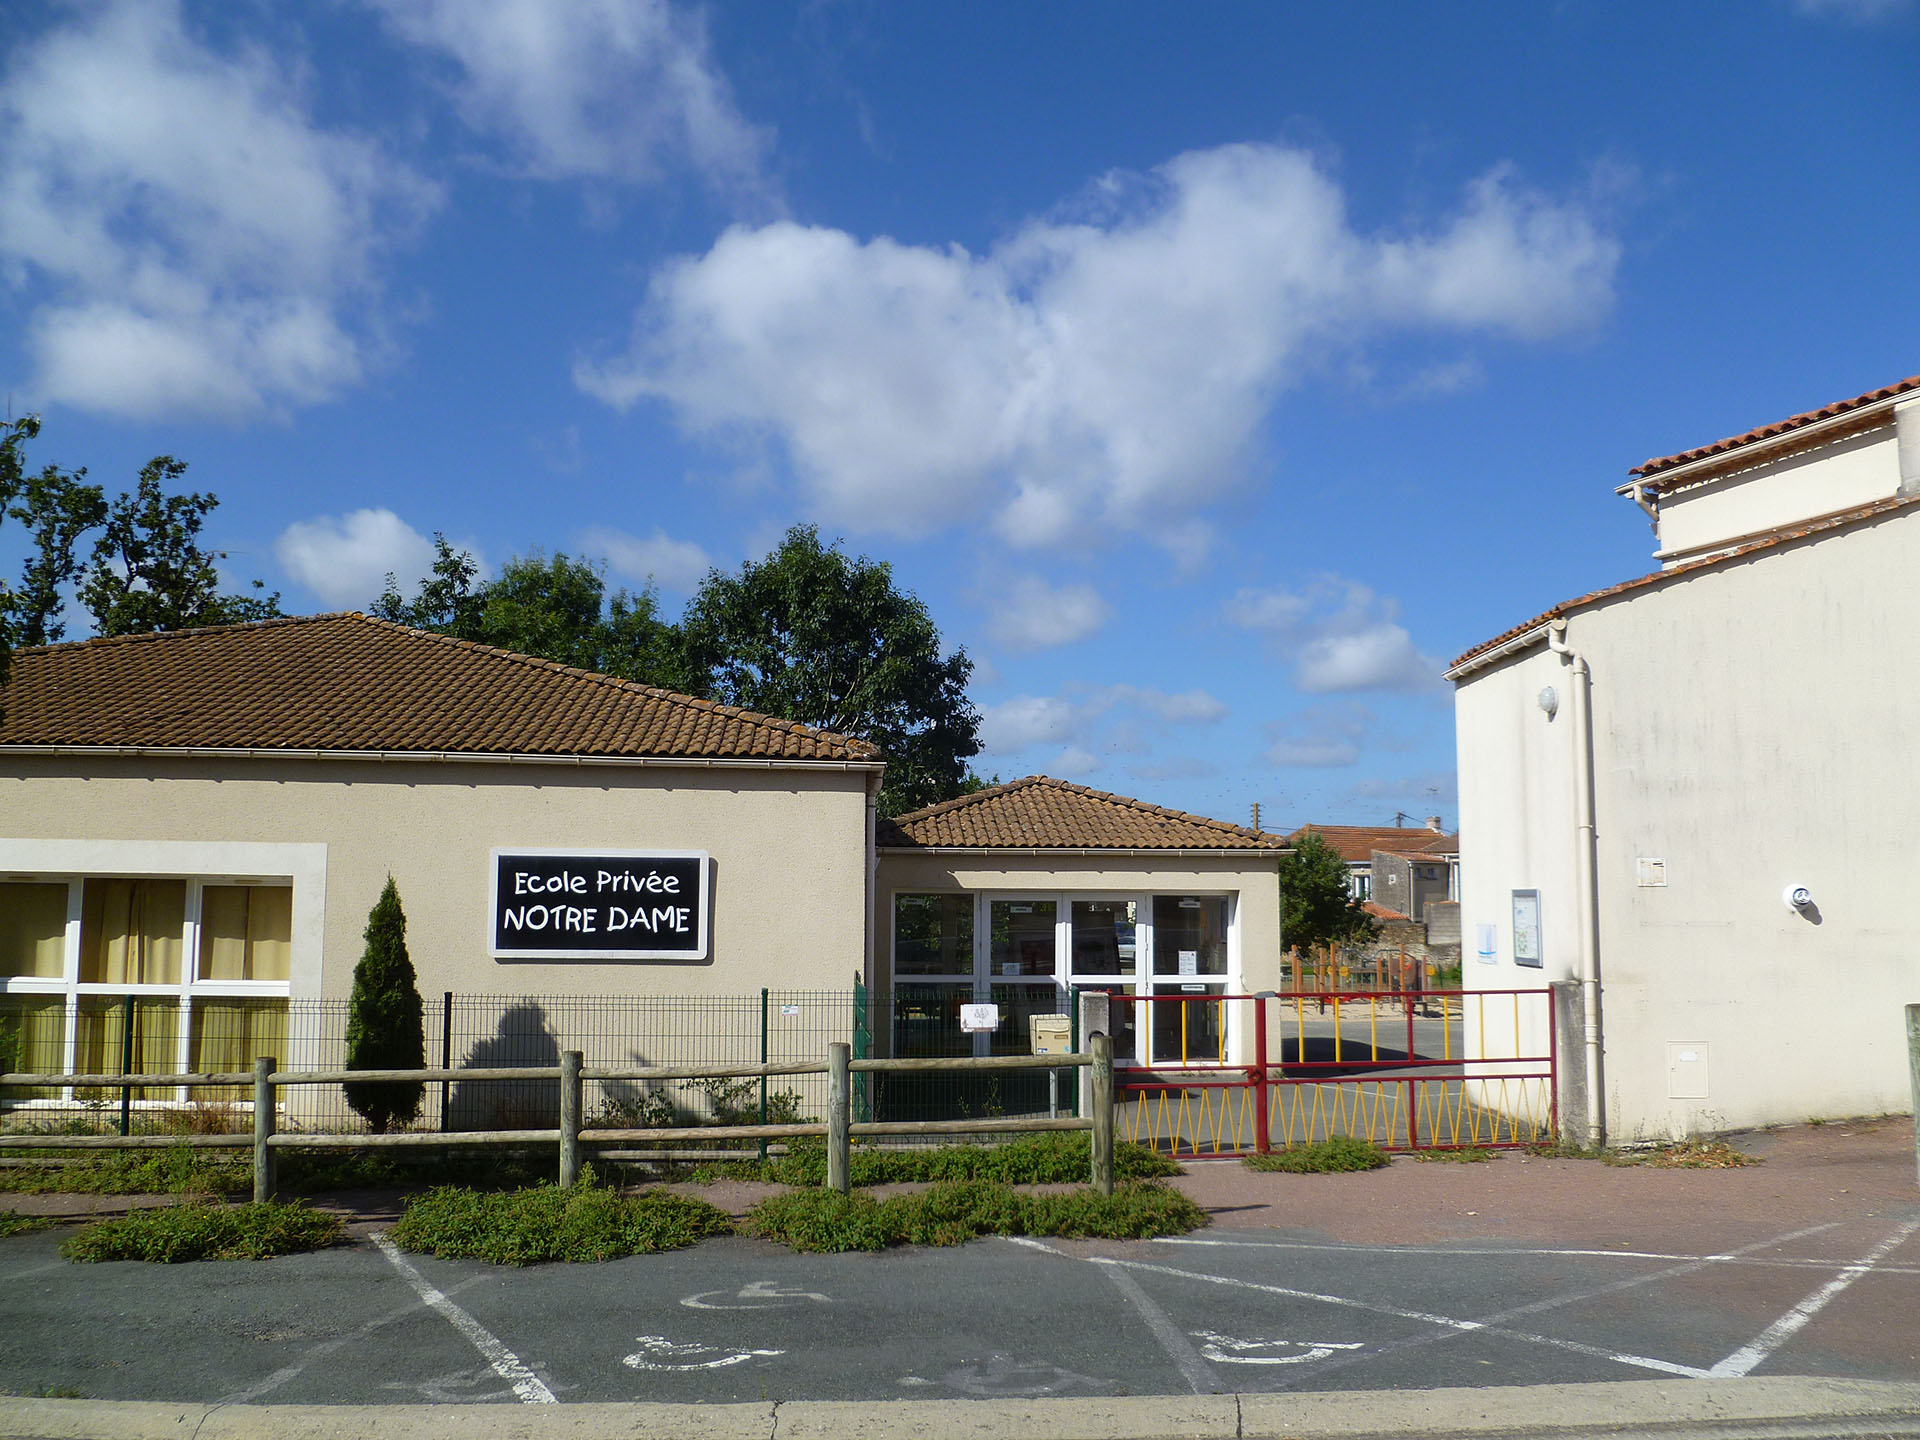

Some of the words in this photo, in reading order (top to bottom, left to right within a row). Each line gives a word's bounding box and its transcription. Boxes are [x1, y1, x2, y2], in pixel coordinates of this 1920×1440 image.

[515, 870, 587, 894] Ecole
[597, 870, 680, 893] Privée
[504, 905, 597, 933] NOTRE
[607, 906, 690, 933] DAME
